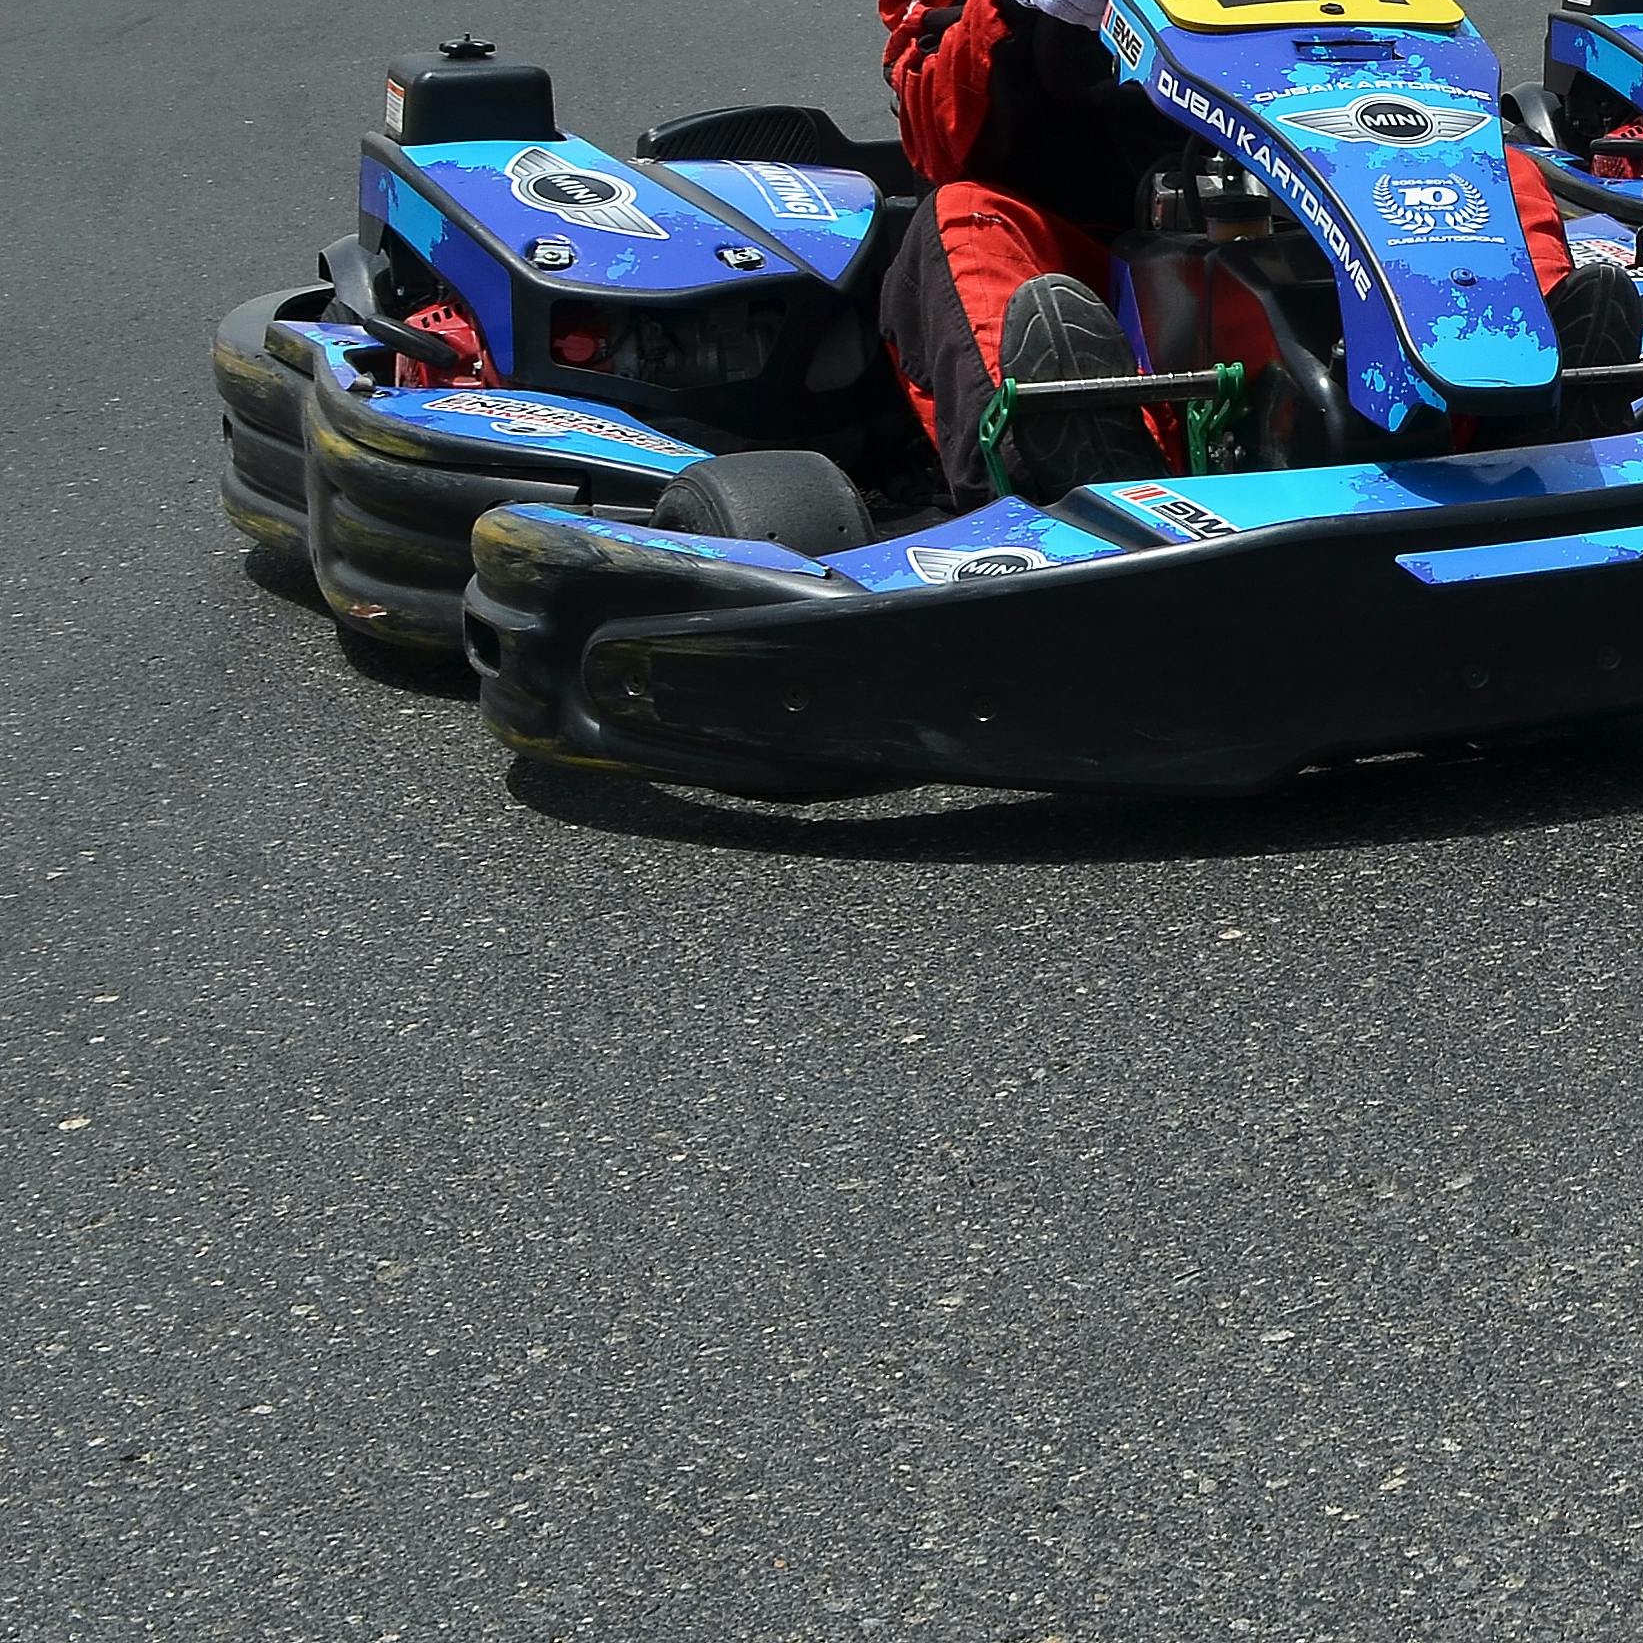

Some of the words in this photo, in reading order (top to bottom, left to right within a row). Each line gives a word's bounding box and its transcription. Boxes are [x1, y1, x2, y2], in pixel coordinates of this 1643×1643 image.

[1113, 14, 1145, 69] SWS
[1255, 84, 1333, 102] DUBAI
[1336, 79, 1492, 101] KARTDROME
[1363, 113, 1426, 128] MINI
[544, 174, 602, 205] MINI
[1157, 69, 1235, 139] DUBAI
[1237, 125, 1372, 301] KARTDROME
[1398, 187, 1458, 207] 10
[1387, 236, 1427, 246] DUBAI
[1152, 502, 1234, 540] SW
